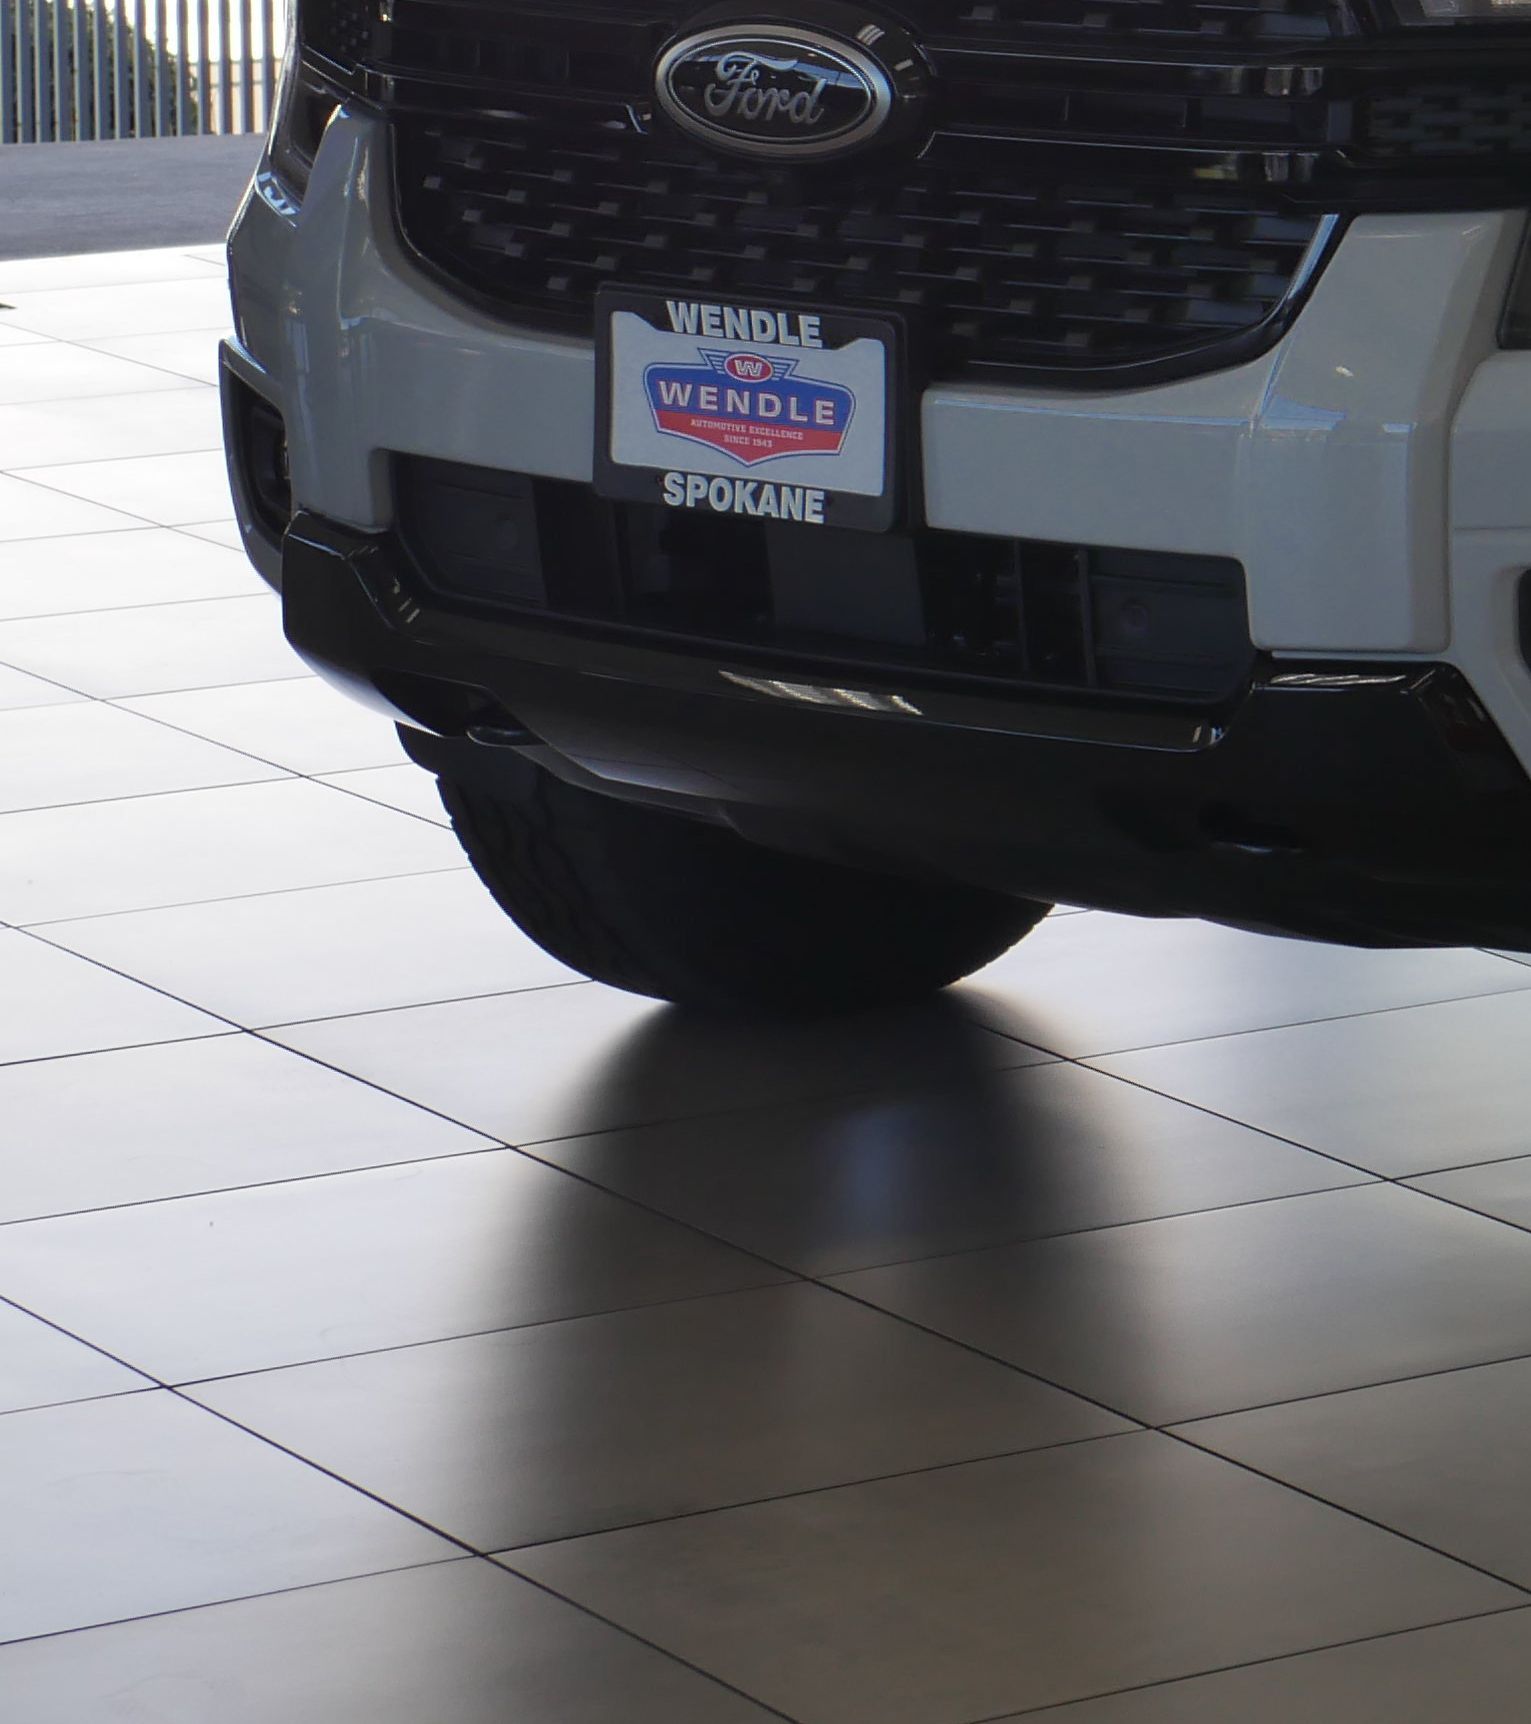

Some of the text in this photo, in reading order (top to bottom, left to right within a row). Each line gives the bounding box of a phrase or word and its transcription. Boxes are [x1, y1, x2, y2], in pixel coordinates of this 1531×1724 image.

[703, 50, 825, 125] Ford
[665, 299, 824, 349] WENDLE
[657, 379, 836, 426] WENDLE
[690, 418, 804, 440] AUTOMOTIVE EXCELLENCE
[724, 434, 750, 445] SINCE
[662, 471, 826, 524] SPOKANE
